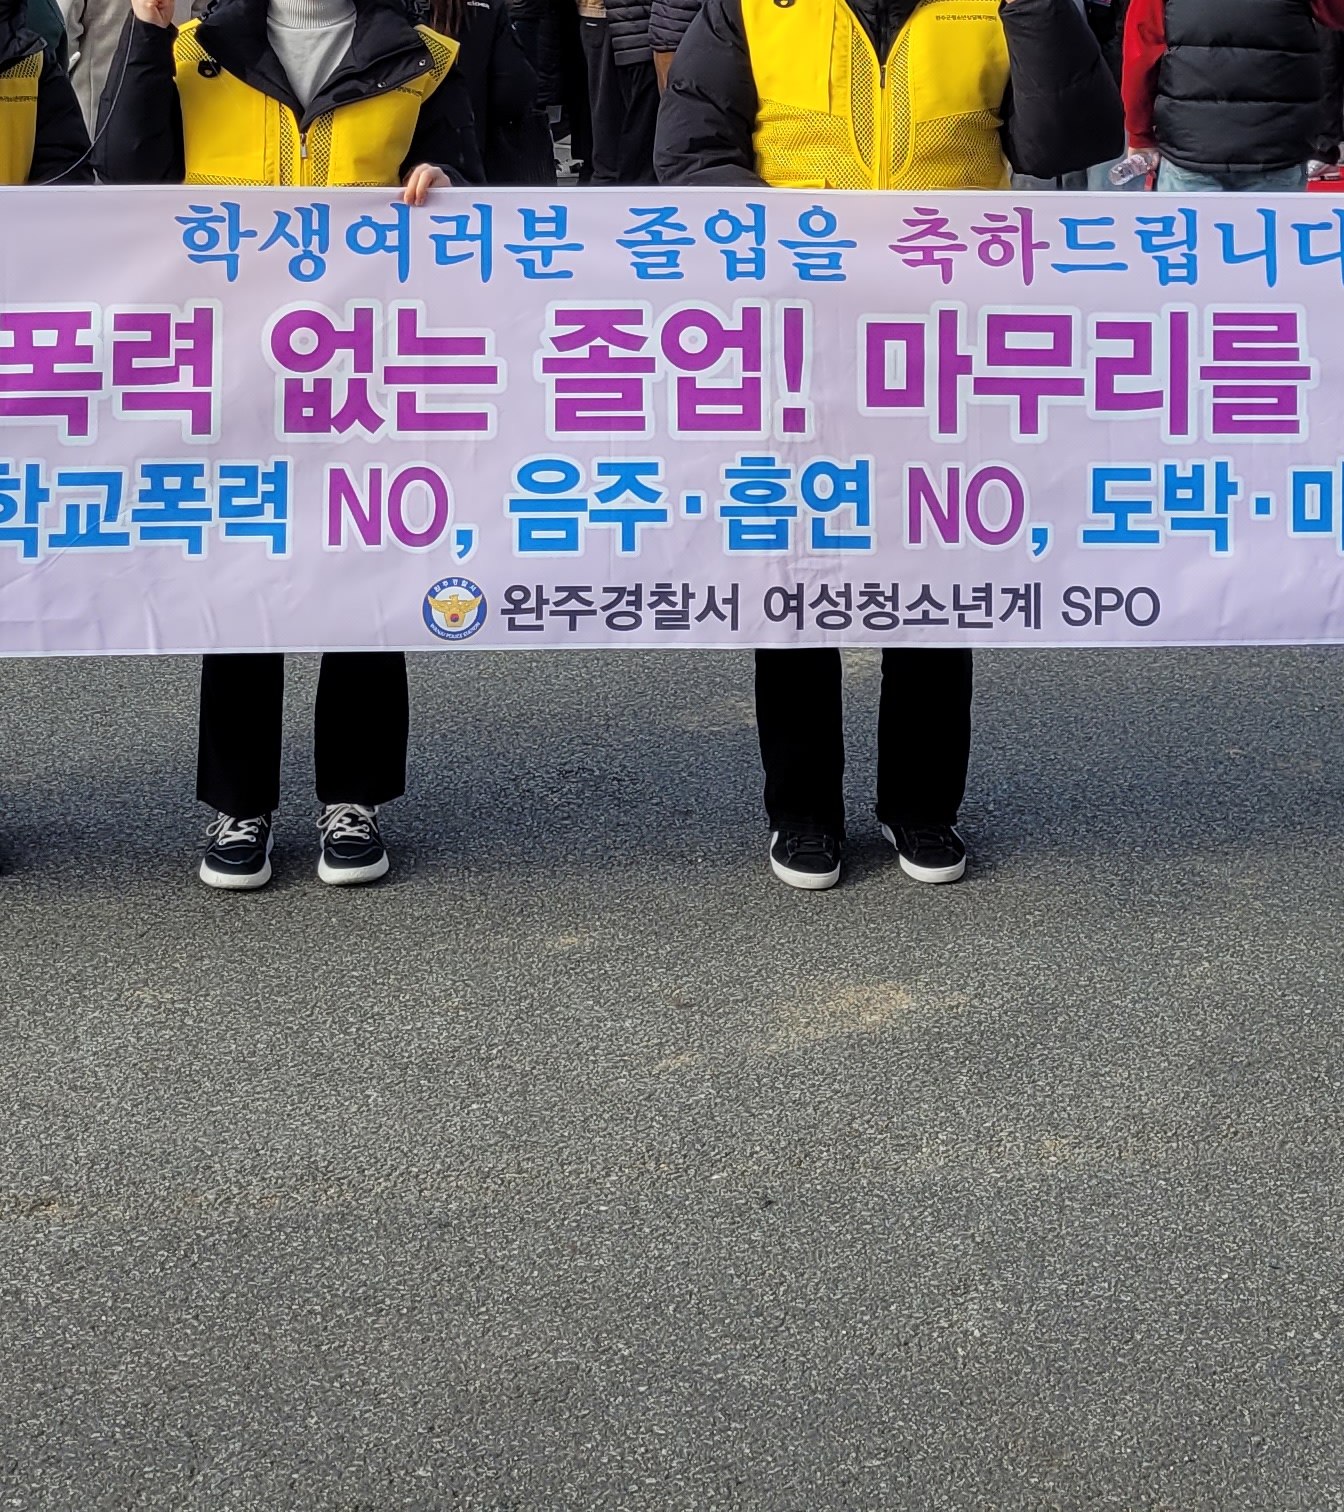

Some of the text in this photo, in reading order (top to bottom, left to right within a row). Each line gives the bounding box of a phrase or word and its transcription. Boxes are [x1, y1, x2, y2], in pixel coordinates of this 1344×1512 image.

[177, 202, 584, 282] 학생여러분
[616, 205, 856, 282] 졸업을
[270, 307, 499, 434] 없는
[541, 307, 805, 434] 졸업!
[865, 309, 1312, 436] 마무리를
[328, 467, 476, 560] NO,
[907, 466, 1050, 556] NO,
[500, 582, 1160, 632] 완주경찰서 여성청소년계 SPO
